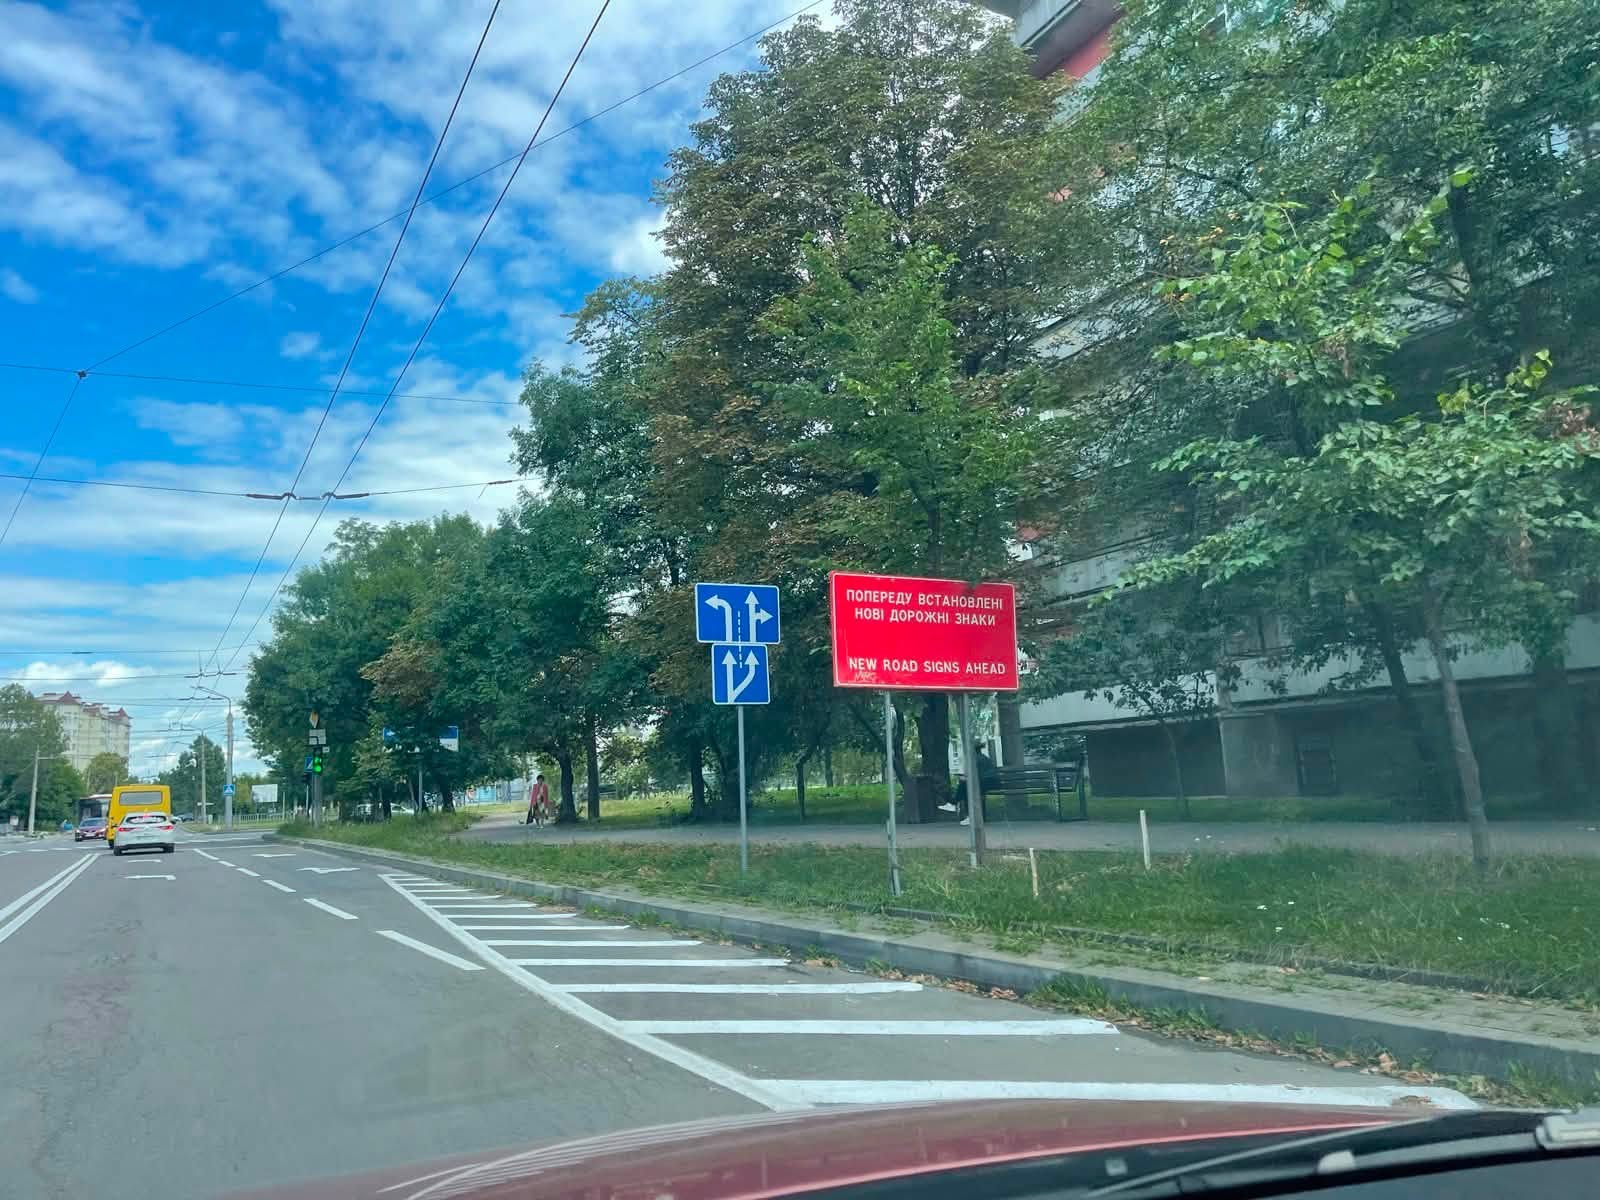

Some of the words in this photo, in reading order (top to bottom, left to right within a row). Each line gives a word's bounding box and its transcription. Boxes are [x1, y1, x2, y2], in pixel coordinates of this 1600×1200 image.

[846, 589, 912, 606] ПОПЕРЕДУ
[918, 593, 1003, 610] ВСТАНОВЛЕНІ
[855, 608, 884, 621] НОВІ
[889, 609, 949, 625] ДОРОЖНІ
[955, 613, 996, 626] ЗНАКИ
[849, 657, 877, 671] NEW
[883, 659, 918, 673] ROAD
[924, 660, 960, 674] SIGNS
[965, 662, 1006, 675] AHEAD
